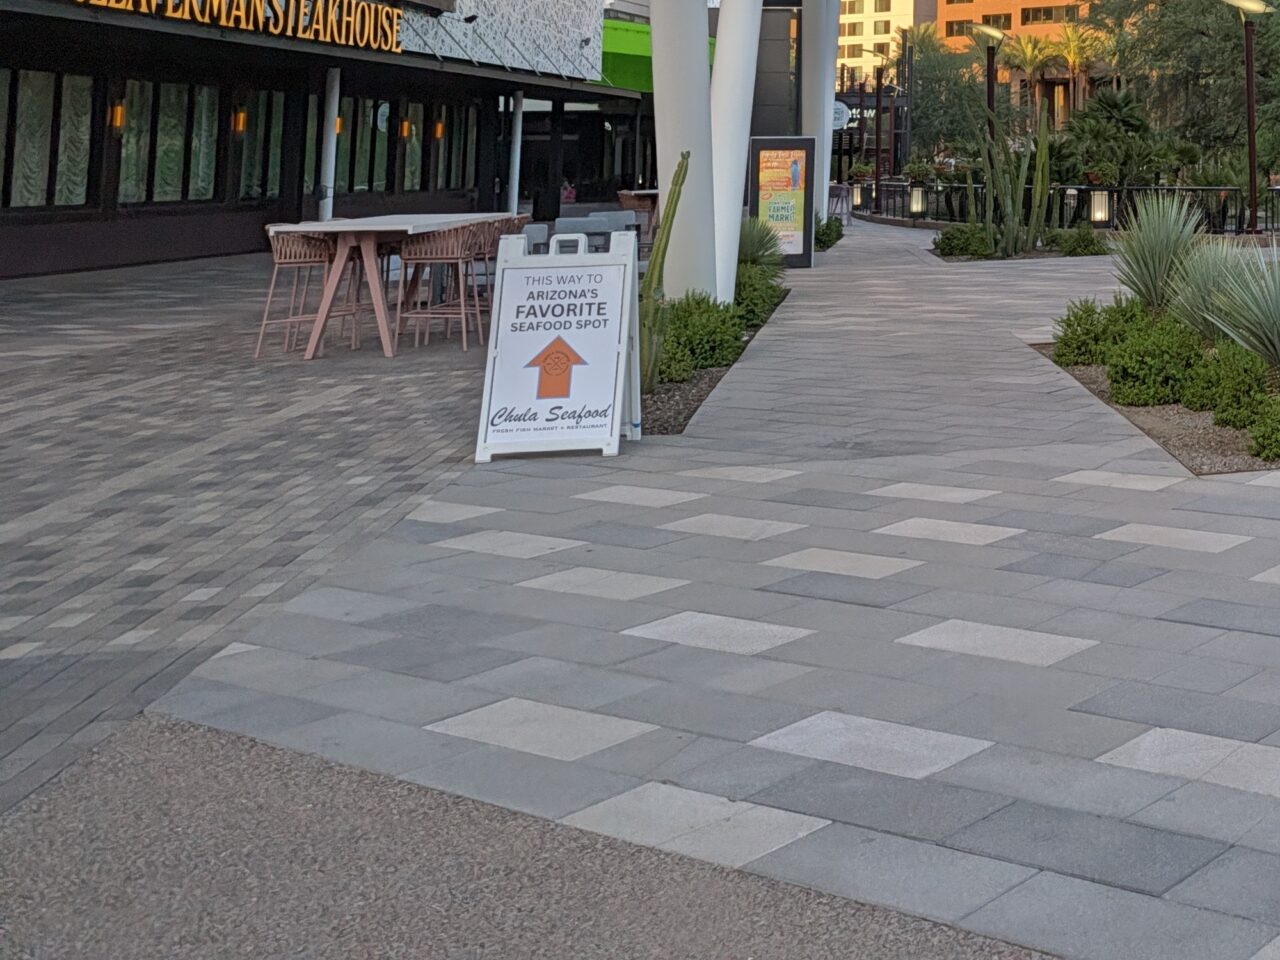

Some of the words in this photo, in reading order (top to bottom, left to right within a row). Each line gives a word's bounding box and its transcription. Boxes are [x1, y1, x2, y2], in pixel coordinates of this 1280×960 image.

[524, 275, 553, 286] THIS
[556, 274, 584, 285] WAY
[586, 273, 604, 284] TO
[526, 288, 599, 302] ARIZONA'S
[515, 302, 608, 319] FAVORITE
[510, 320, 573, 333] SEAFOOD
[575, 318, 610, 330] SPOT
[490, 406, 540, 427] Chula
[545, 404, 612, 425] Seafood
